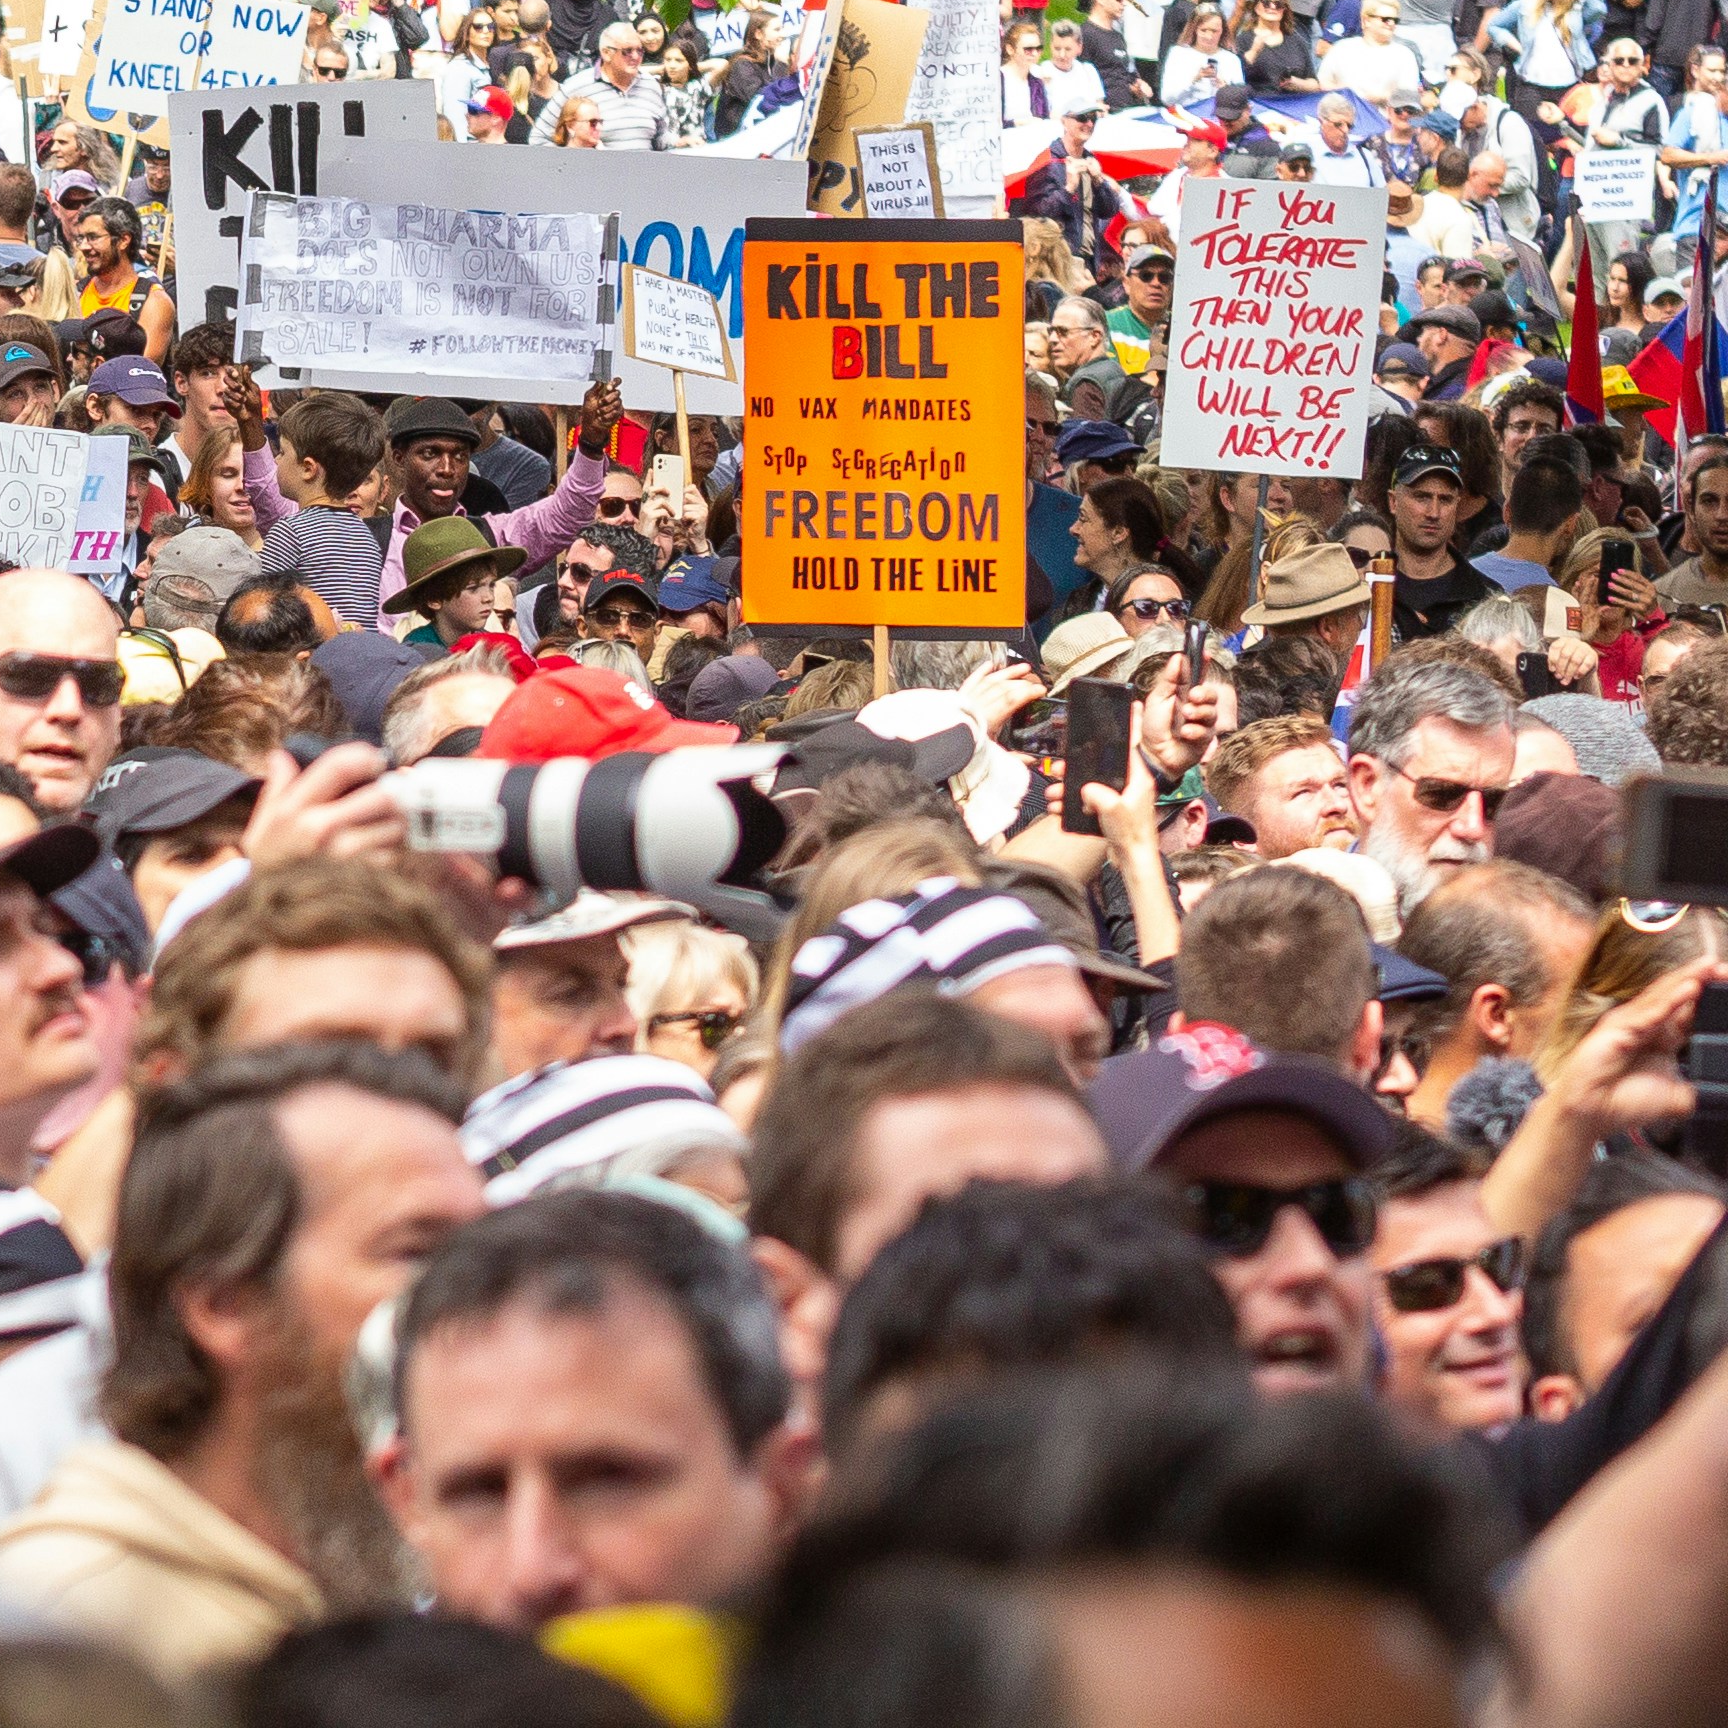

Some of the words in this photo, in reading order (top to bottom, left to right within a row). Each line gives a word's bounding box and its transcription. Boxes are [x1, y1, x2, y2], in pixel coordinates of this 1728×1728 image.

[233, 4, 303, 38] NOW
[928, 7, 989, 29] UILTY!
[180, 31, 213, 57] OR
[108, 59, 185, 92] KNEEL
[870, 144, 900, 157] THIS
[904, 143, 916, 154] IS
[882, 161, 909, 173] NOT
[866, 180, 912, 193] ABOUT
[917, 179, 926, 188] A
[1216, 189, 1254, 219] IF
[297, 202, 370, 240] BIG
[396, 205, 570, 253] PHARMA
[1191, 217, 1367, 270] TOLERATE
[297, 241, 378, 276] DOES
[391, 241, 451, 277] NOT
[463, 249, 540, 286] OWN
[894, 261, 999, 319] THE
[1231, 267, 1310, 299] THIS
[262, 280, 403, 316] FREEDOM
[417, 282, 441, 316] IS
[452, 283, 512, 319] NOT
[529, 288, 587, 323] FOR
[648, 299, 682, 321] PUBLIC
[685, 313, 717, 329] HEALTH
[1191, 297, 1272, 329] THEN
[1288, 303, 1363, 339] YOUR
[278, 319, 372, 356] SALE!
[832, 324, 949, 380] BILL
[1180, 326, 1359, 376] CHILDREN
[750, 396, 775, 418] NO
[798, 397, 838, 420] VAX
[862, 397, 971, 422] MANDATES
[1197, 376, 1288, 419] WILL
[1298, 386, 1354, 420] BE
[1218, 424, 1346, 470] NEXT!!
[765, 489, 999, 542] FREEDOM
[70, 531, 120, 561] TH
[792, 557, 859, 592] HOLD
[870, 557, 923, 592] THE
